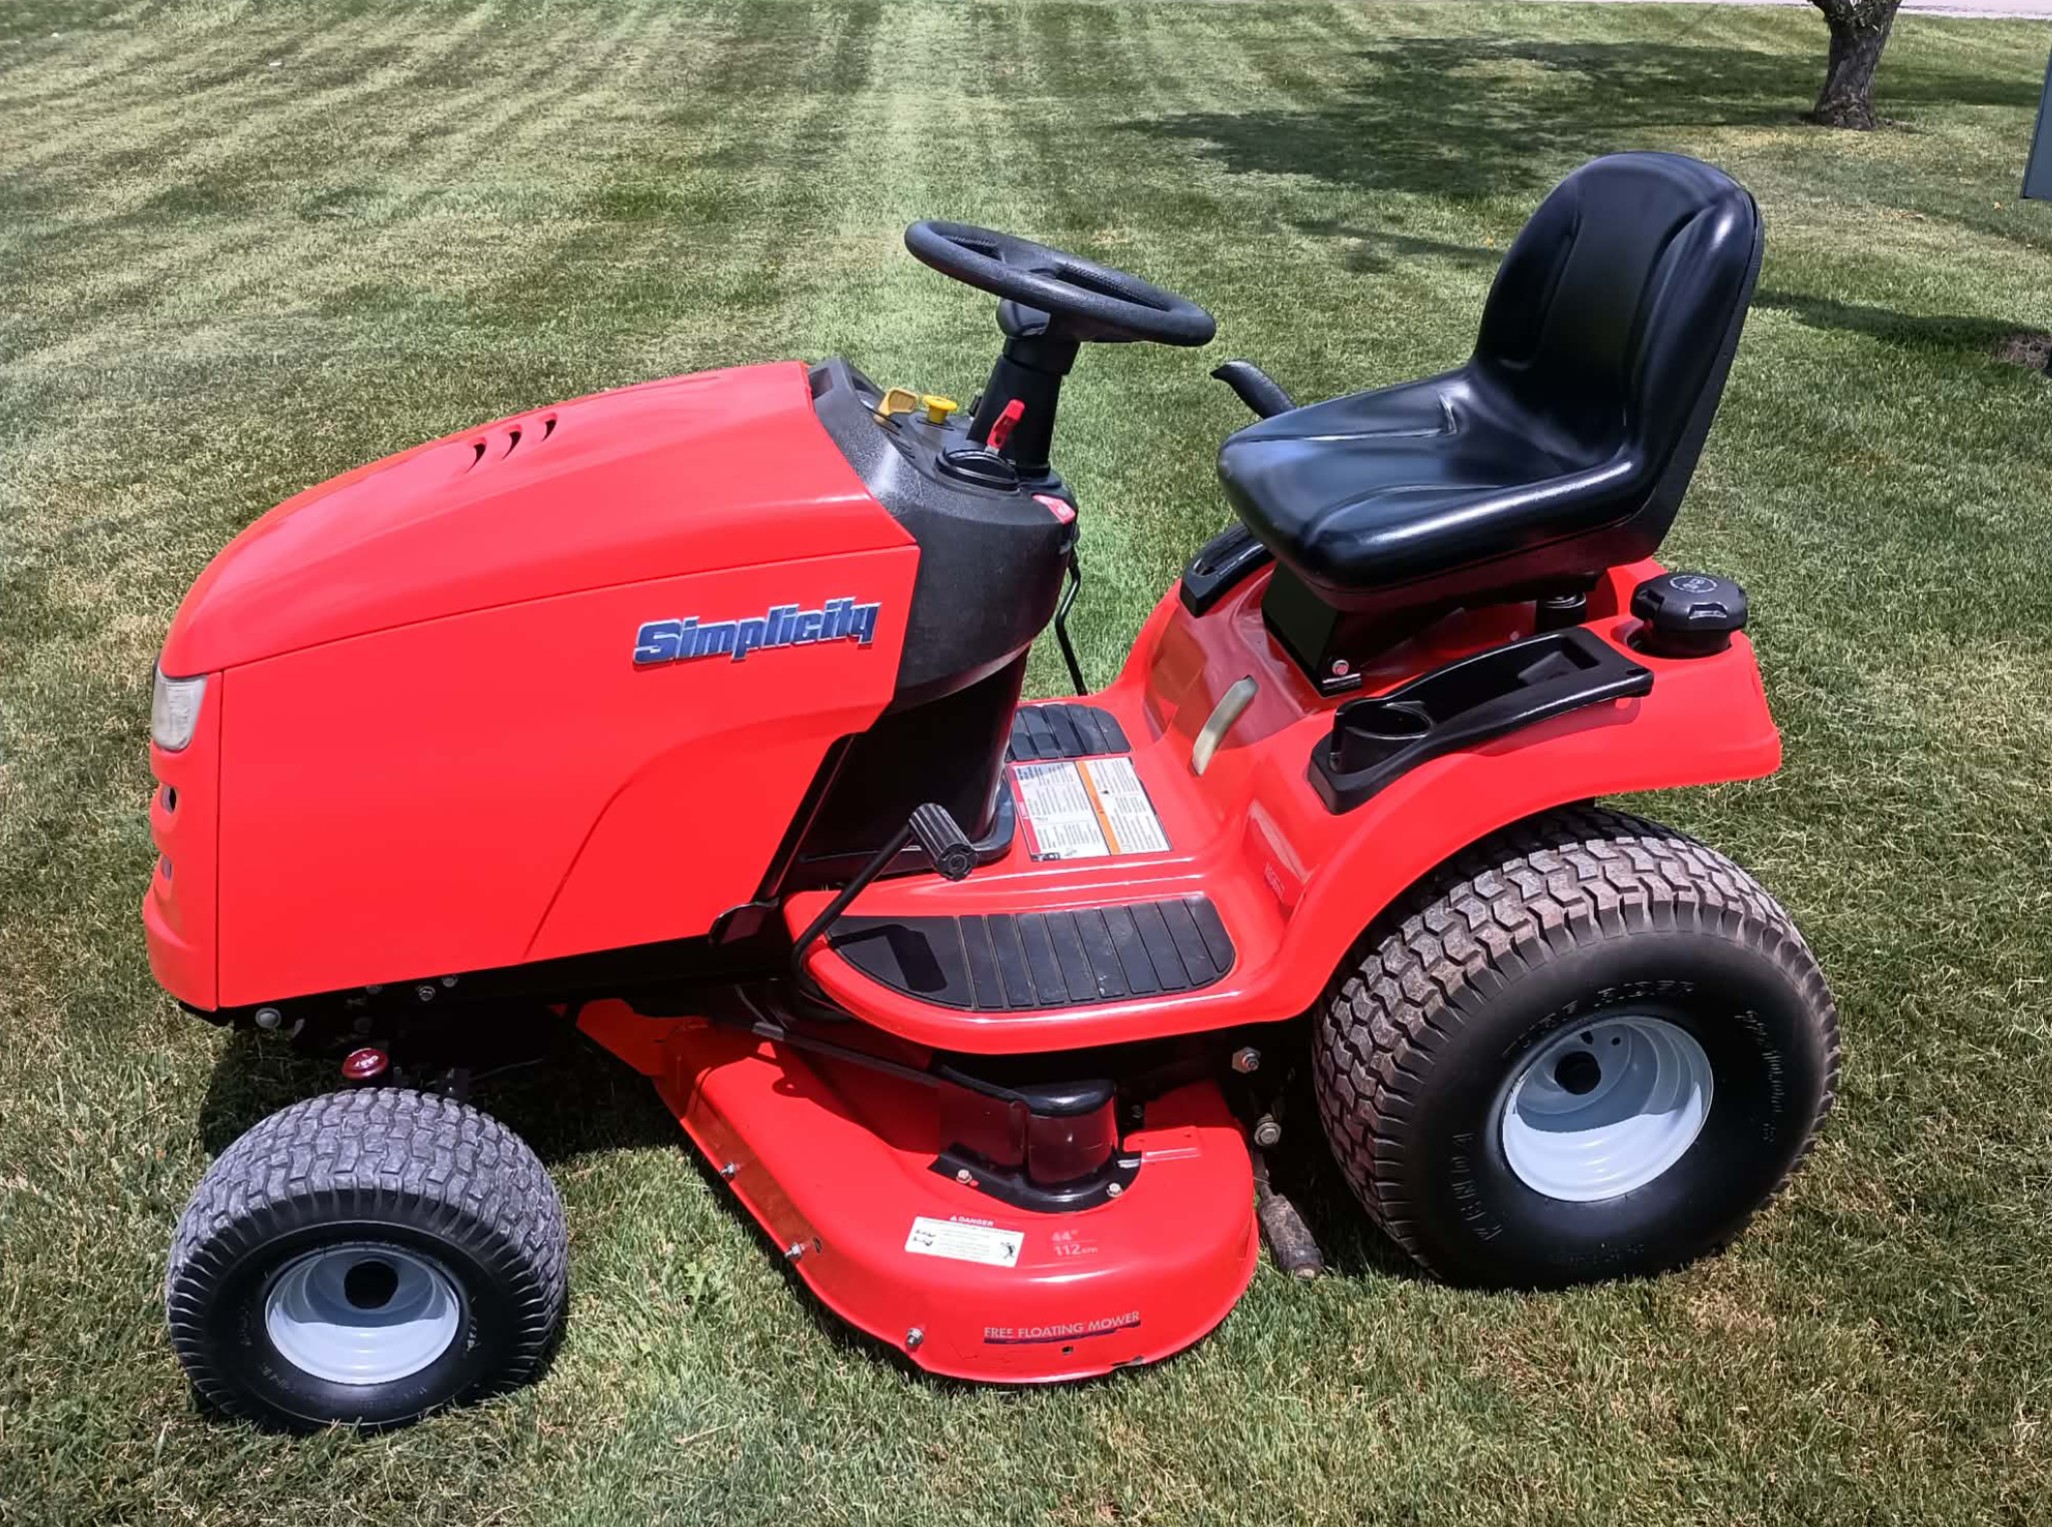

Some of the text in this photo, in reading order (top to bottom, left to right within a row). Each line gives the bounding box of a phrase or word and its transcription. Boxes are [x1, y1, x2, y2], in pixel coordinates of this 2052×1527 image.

[634, 597, 882, 664] Simplicity
[958, 1216, 995, 1227] DANGER
[984, 1311, 1140, 1338] FREE FLOATING MOWER
